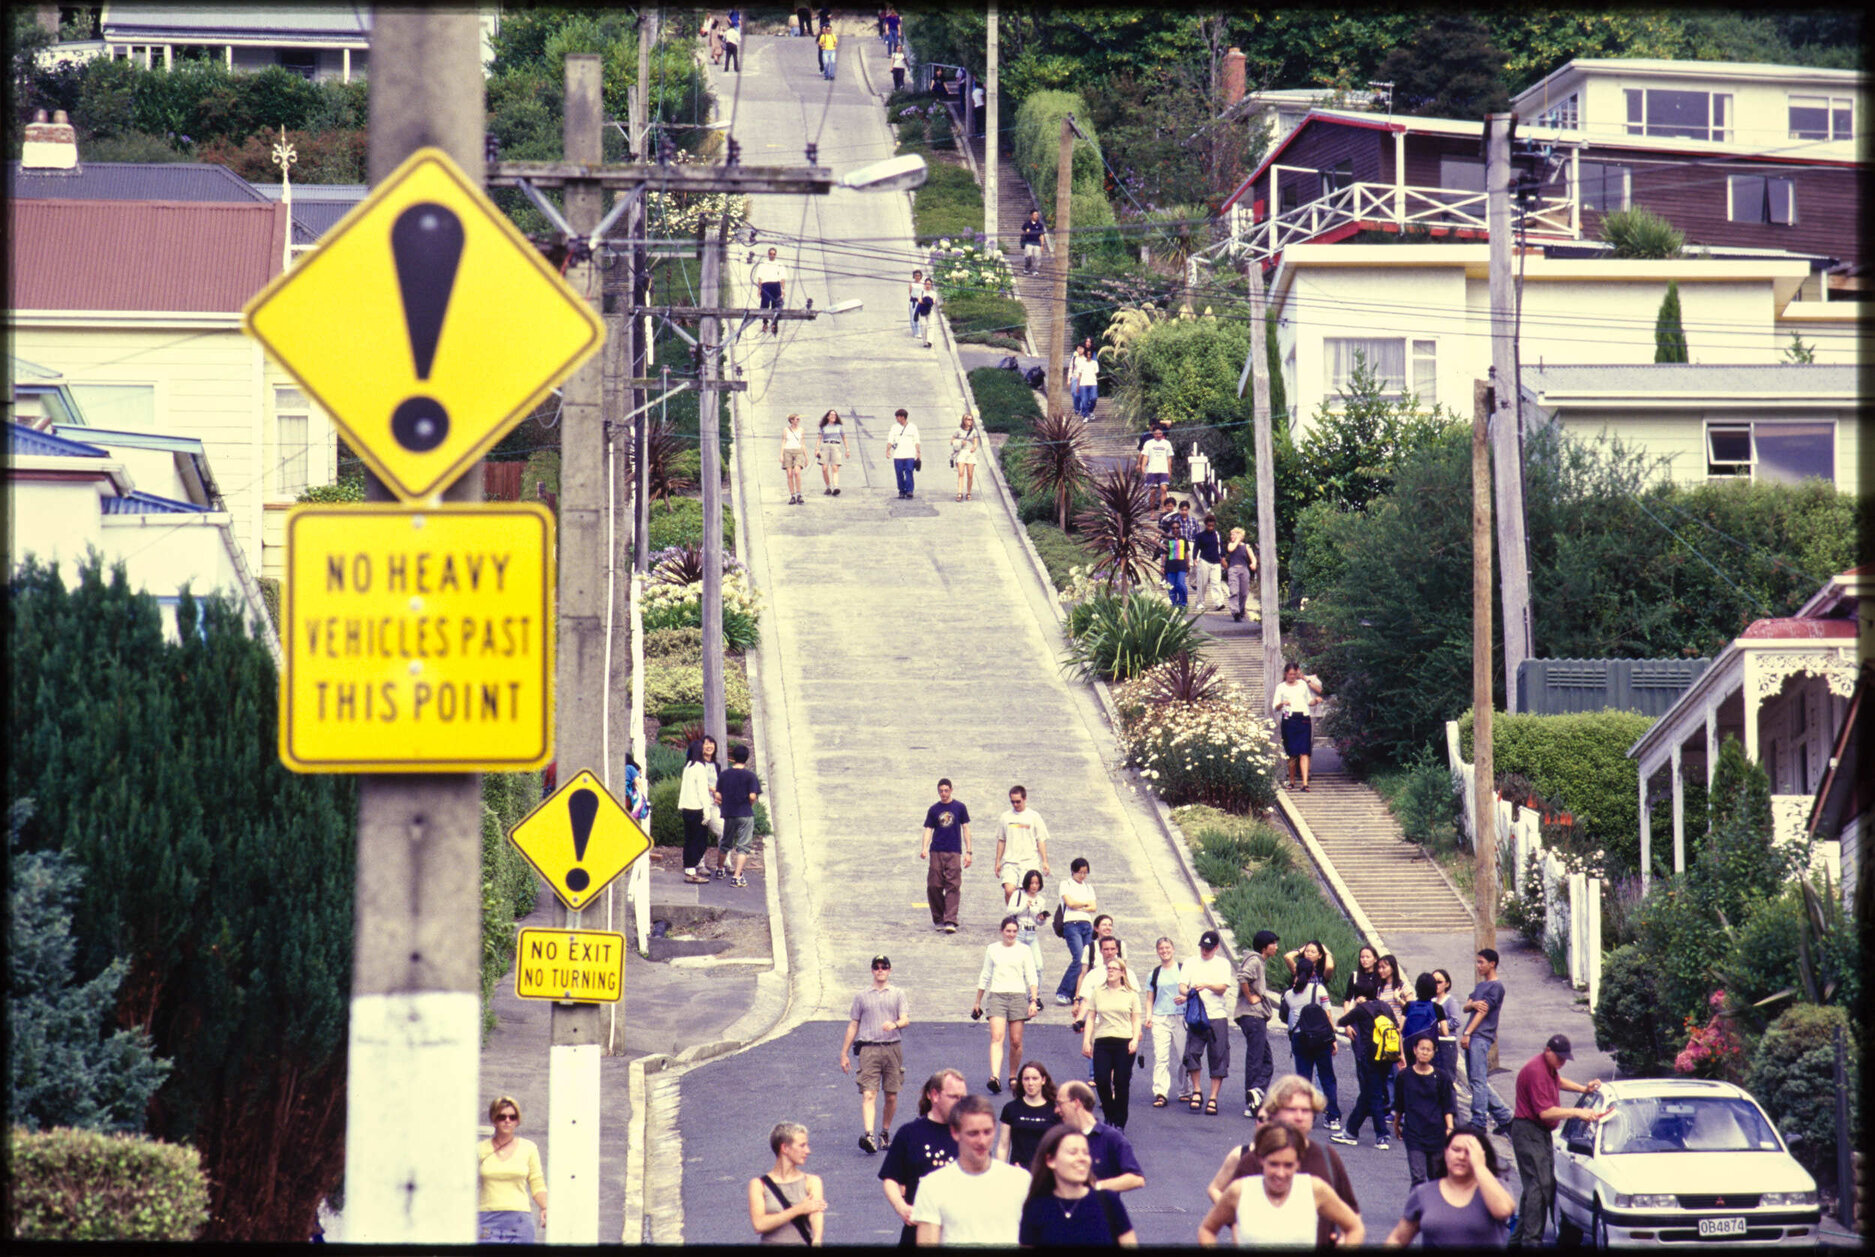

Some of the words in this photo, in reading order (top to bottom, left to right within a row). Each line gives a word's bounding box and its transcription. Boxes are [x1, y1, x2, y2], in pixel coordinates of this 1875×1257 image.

[326, 552, 372, 593] NO
[387, 553, 511, 594] HEAVY
[305, 616, 449, 658] VEHICLES
[460, 616, 532, 658] PAST
[315, 681, 398, 723] THIS
[413, 682, 521, 723] POINT
[531, 941, 557, 960] NO
[569, 943, 611, 963] EXIT
[524, 968, 543, 987] NO
[552, 968, 616, 990] TURNING
